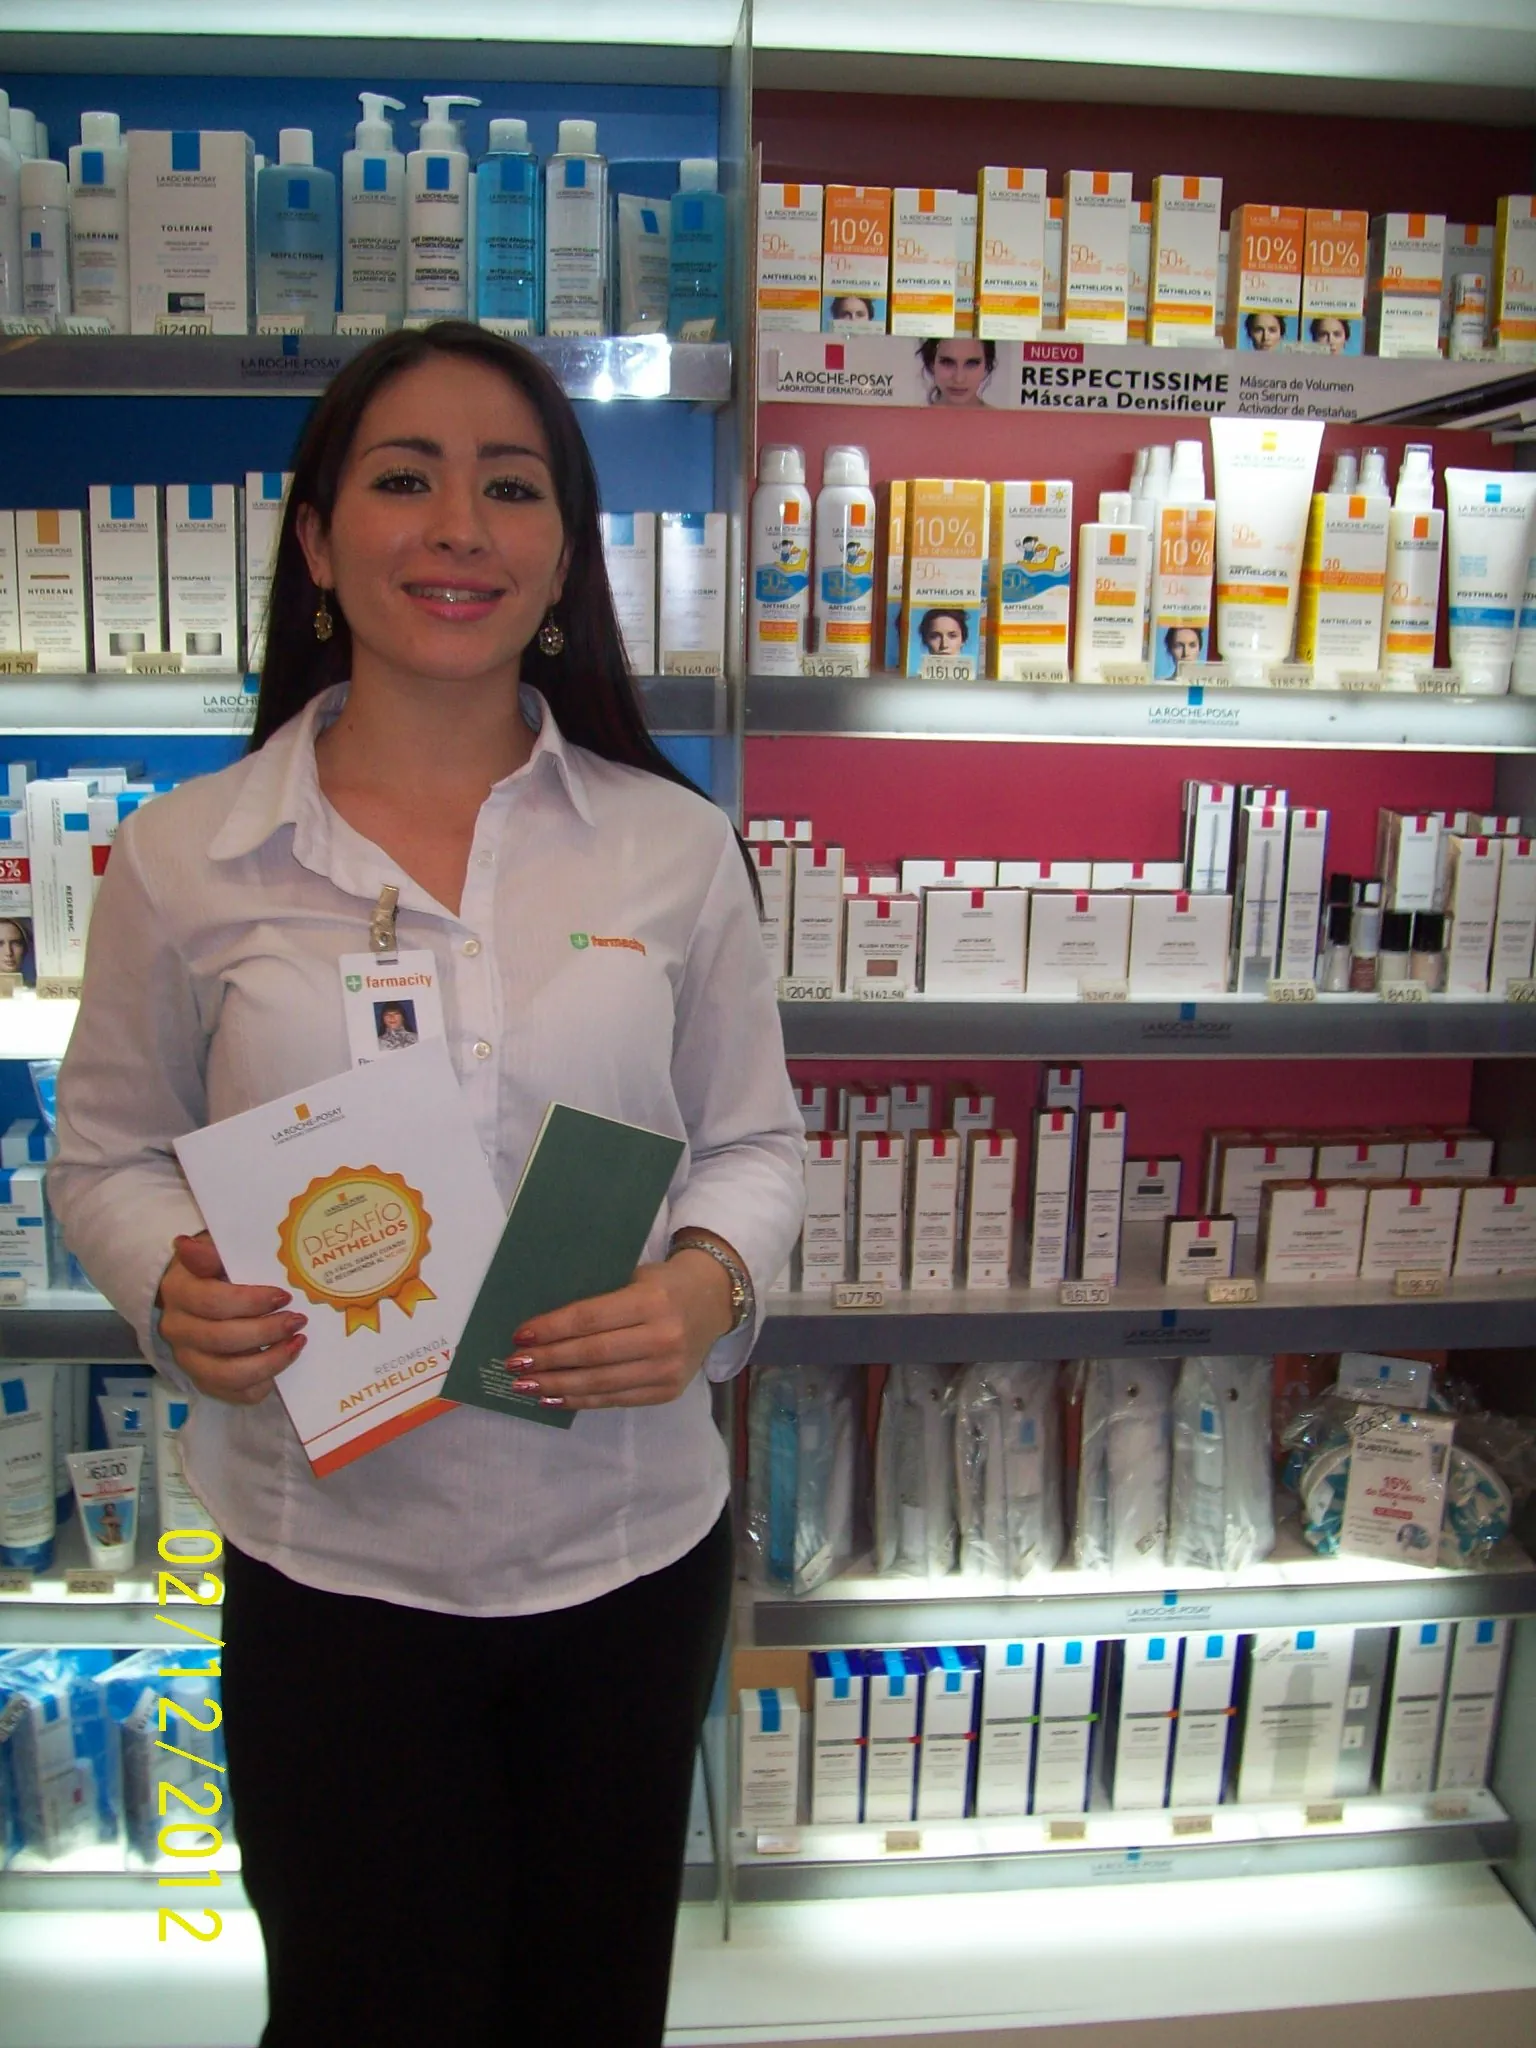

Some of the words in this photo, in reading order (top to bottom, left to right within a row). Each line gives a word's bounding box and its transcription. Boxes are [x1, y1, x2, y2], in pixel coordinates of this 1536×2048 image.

[161, 224, 214, 233] TOLERIANE
[830, 217, 885, 247] 10%
[270, 251, 324, 261] RESPECTISSIME
[1245, 234, 1298, 265] 10%
[1308, 238, 1361, 268] 10%
[761, 273, 807, 283] ANTHELIOS
[831, 278, 870, 287] ANTHELIOS
[896, 277, 939, 286] ANTHELIOS
[942, 278, 952, 287] XL
[984, 278, 1027, 288] ANTHELIOS
[1029, 279, 1039, 288] XL
[1070, 282, 1114, 293] ANTHELIOS
[1158, 288, 1202, 298] ANTHELIOS
[1245, 295, 1284, 304] ANTHELIOS
[1309, 299, 1348, 308] ANTHELIOS
[1385, 309, 1424, 317] ANTHELIOS
[1030, 344, 1079, 361] NUEVO
[241, 358, 256, 369] LA
[794, 370, 894, 389] ROCHE-POSAY
[1020, 366, 1230, 394] RESPECTISSIME
[1239, 374, 1289, 390] Máscara
[1290, 377, 1305, 390] de
[1305, 378, 1355, 393] Volumen
[776, 384, 826, 396] LABORATOIRE
[826, 386, 894, 399] DERMATOLOGIQUE
[1238, 391, 1260, 402] con
[1261, 390, 1300, 404] Serum
[1020, 388, 1109, 409] Máscara
[1116, 391, 1227, 414] Densifieur
[1238, 403, 1290, 417] Activador
[1291, 405, 1306, 417] de
[1307, 404, 1359, 421] Pestañas
[914, 515, 977, 548] 10%
[1160, 538, 1212, 567] 10%
[1323, 557, 1341, 571] 30
[1229, 567, 1277, 579] ANTHELIOS
[1095, 577, 1117, 591] 50+
[27, 588, 75, 596] HYDREANE
[915, 588, 964, 598] ANTHELIOS
[965, 590, 977, 598] XL
[1456, 590, 1509, 600] POSTHELIOS
[1003, 603, 1044, 612] ANTHELIOS
[203, 695, 219, 706] LA
[1149, 707, 1161, 717] LA
[1163, 707, 1241, 719] ROCHE-POSAY
[365, 972, 434, 992] farmacity
[271, 1131, 284, 1141] LA
[283, 1106, 343, 1135] ROCHE-POSAY
[302, 1202, 403, 1257] DESAFÍO
[311, 1218, 408, 1269] ANTHELIOS
[339, 1355, 439, 1413] ANTHELIOS
[440, 1349, 451, 1362] Y
